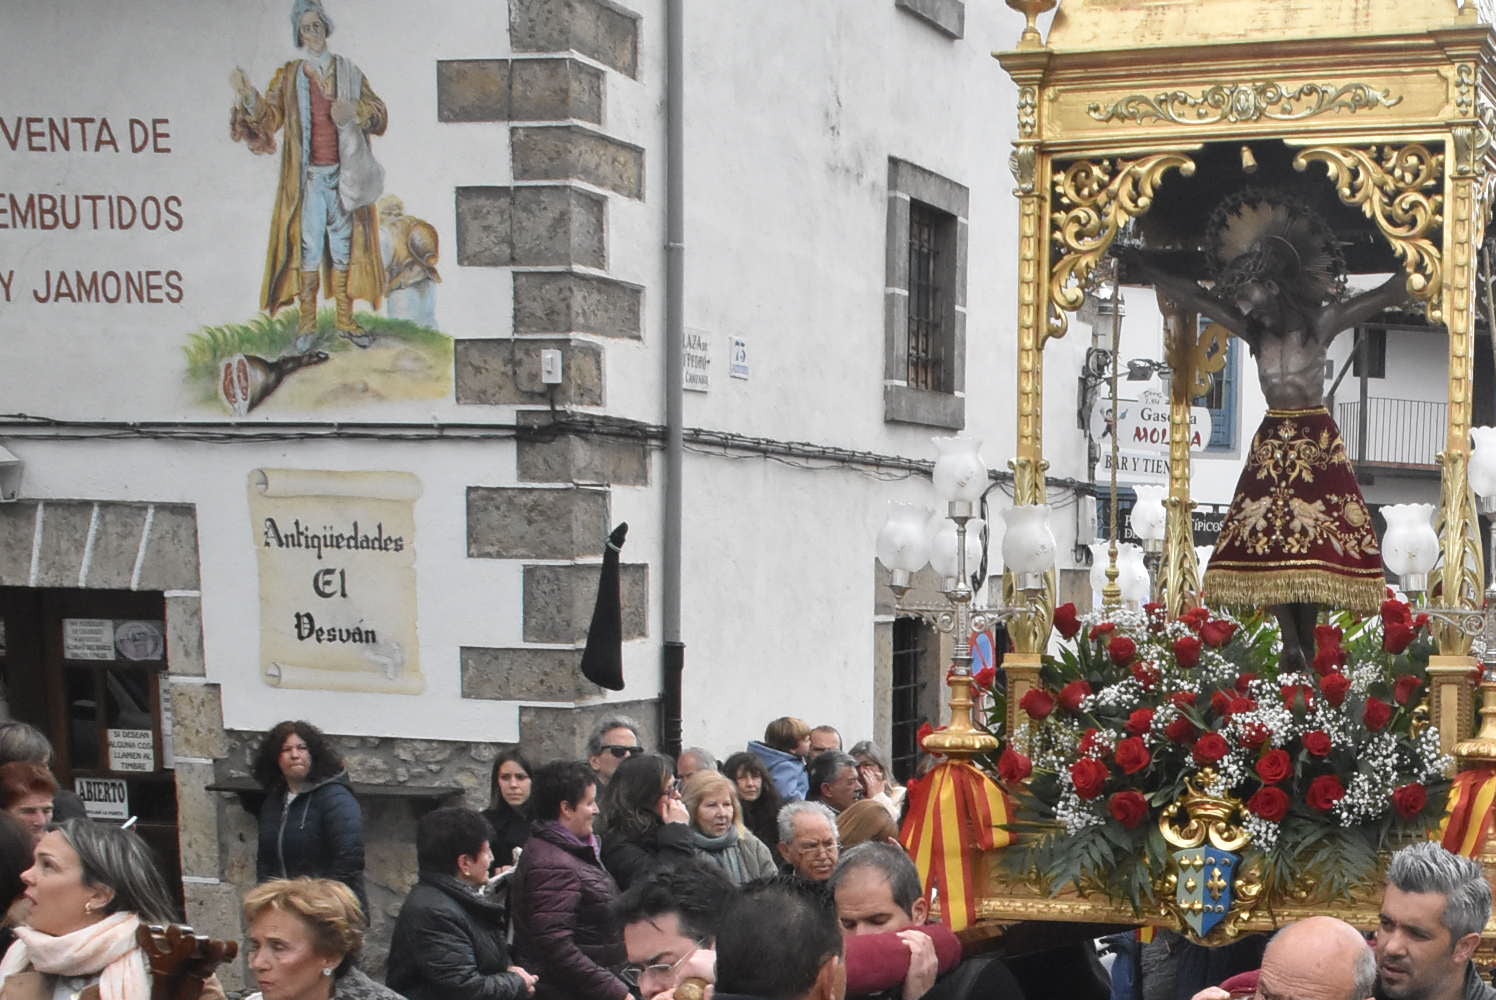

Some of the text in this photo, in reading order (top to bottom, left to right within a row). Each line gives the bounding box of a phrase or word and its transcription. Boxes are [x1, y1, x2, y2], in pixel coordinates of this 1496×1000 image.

[0, 117, 171, 153] VENTA DE
[0, 270, 183, 304] Y JAMONES
[1140, 407, 1197, 425] Gasa
[1133, 426, 1201, 447] MOLA
[1132, 457, 1139, 472] Y
[1143, 458, 1170, 475] TIEN
[312, 568, 347, 598] El
[80, 781, 126, 804] ABIERTO
